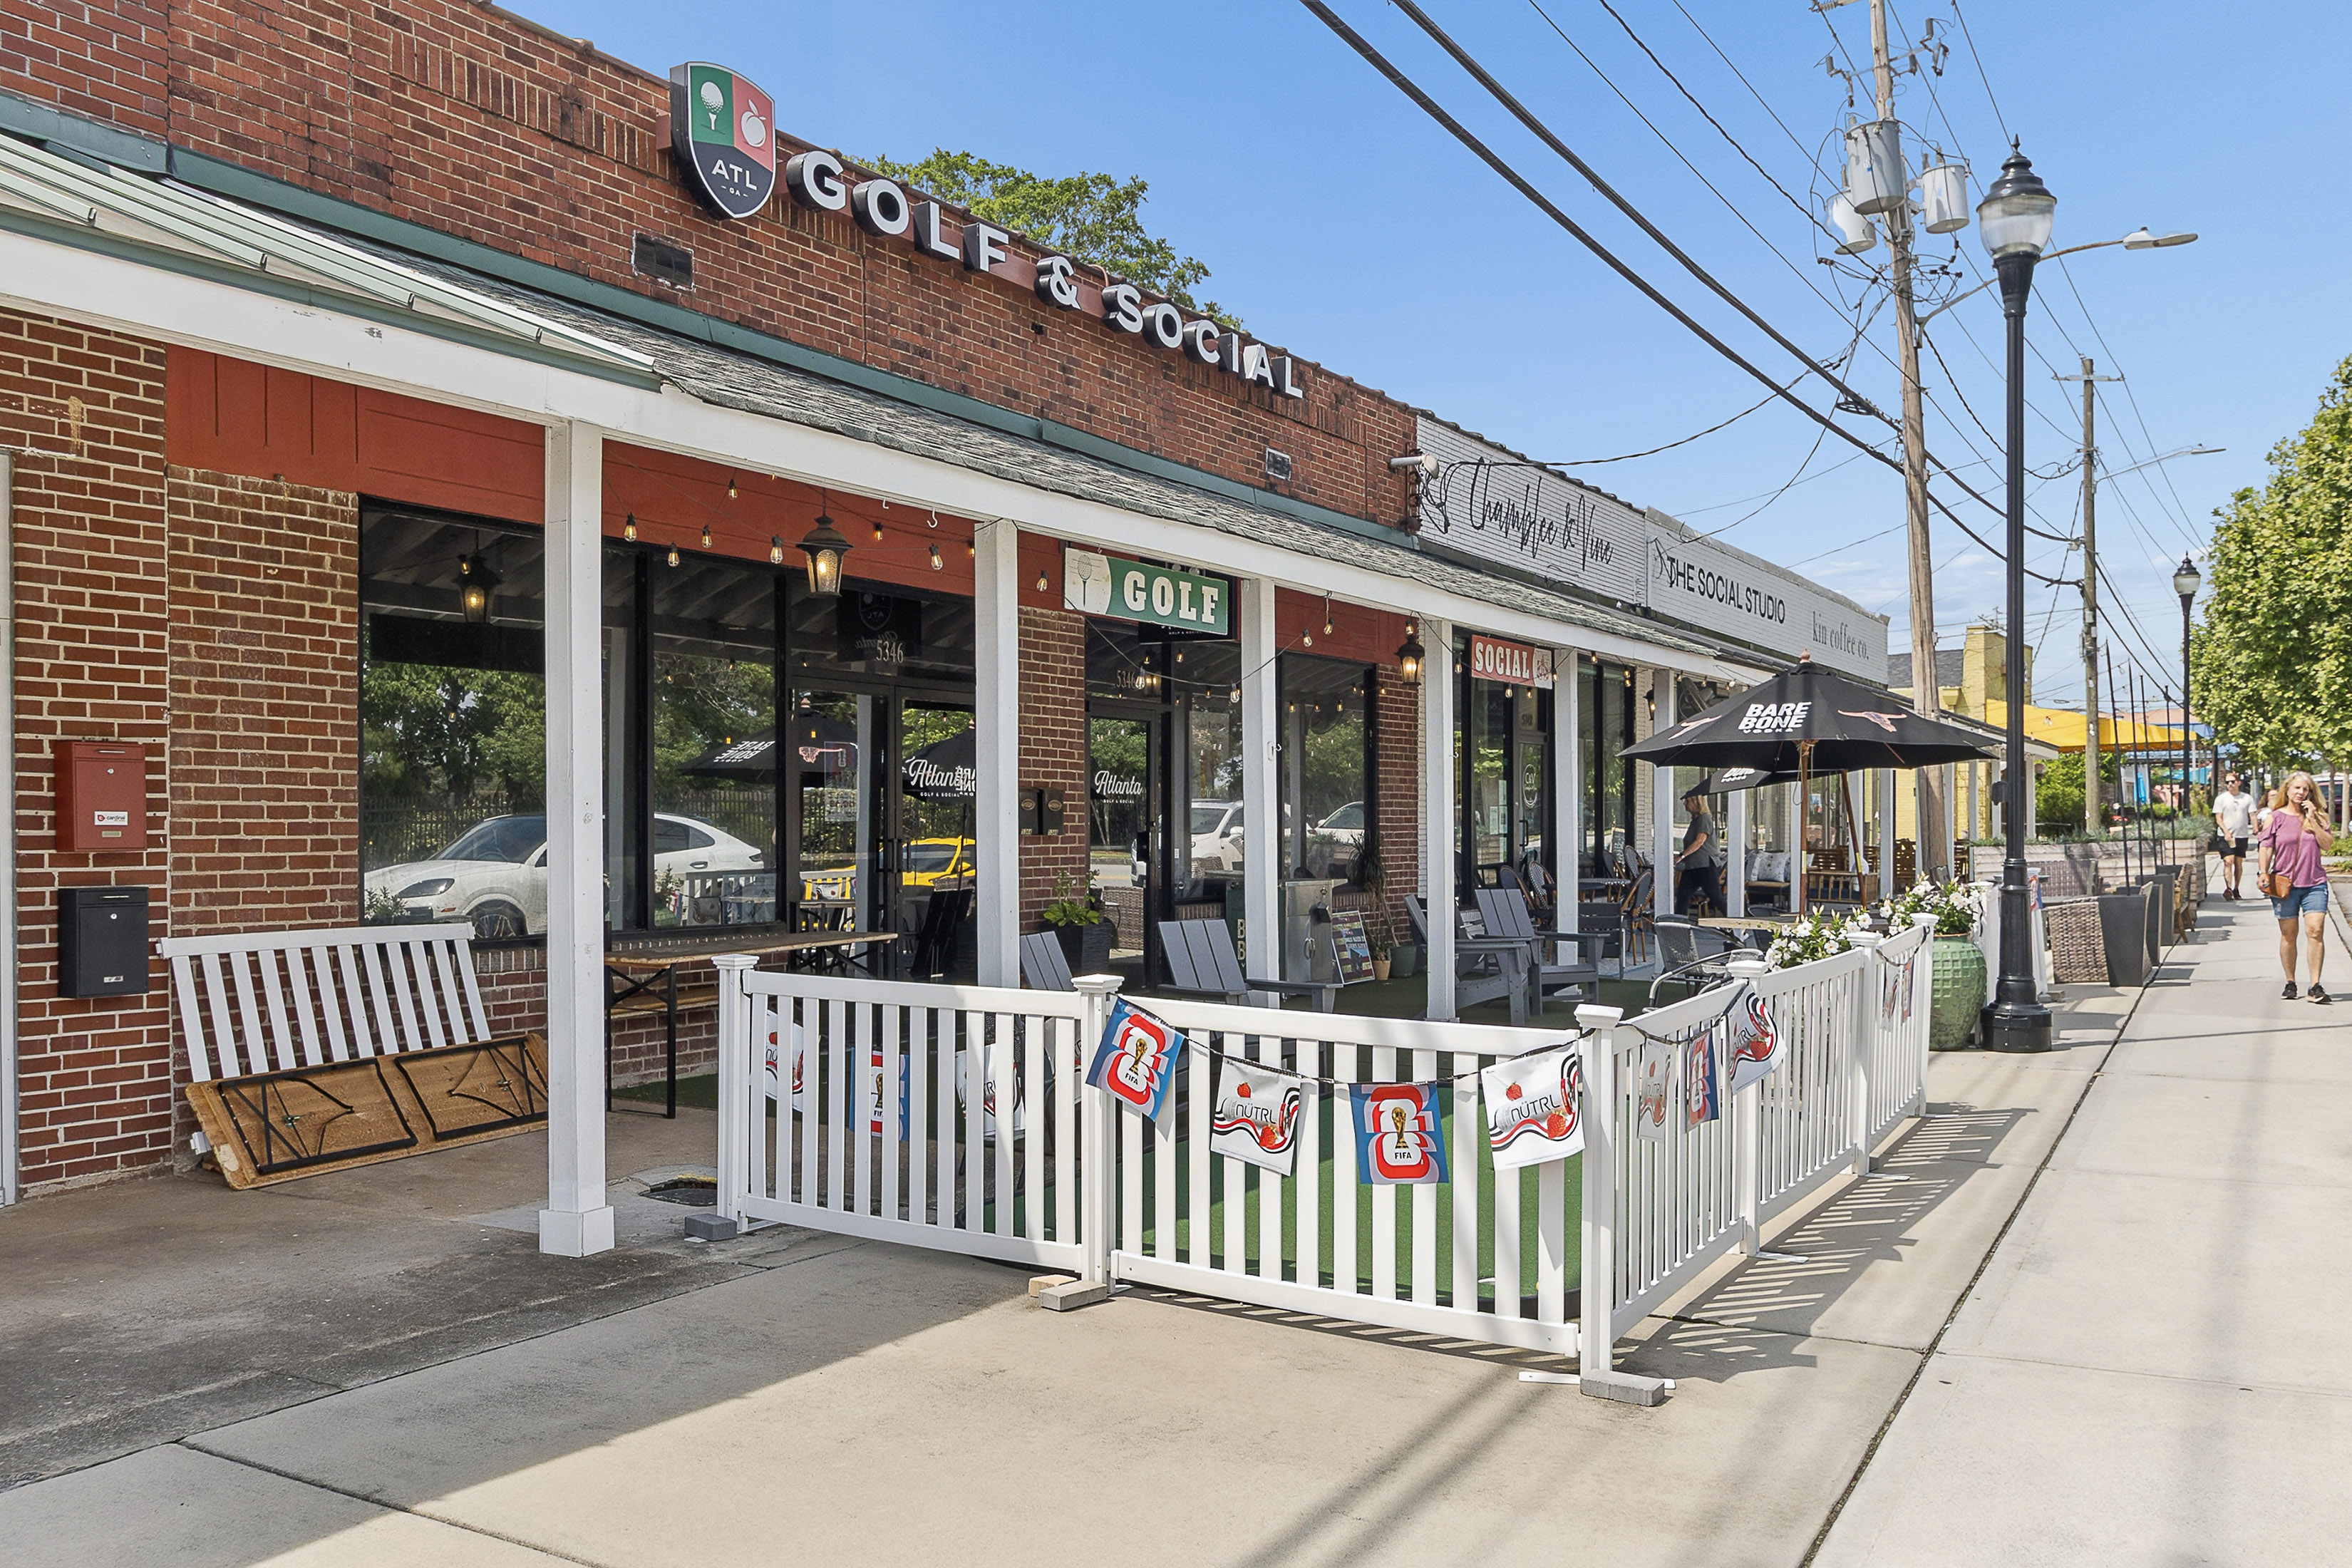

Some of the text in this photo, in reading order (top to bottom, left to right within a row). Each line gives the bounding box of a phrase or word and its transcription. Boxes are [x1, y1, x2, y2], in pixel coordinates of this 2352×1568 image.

[711, 159, 757, 191] ATL
[790, 150, 1304, 400] GOLF & SOCIAL
[1124, 571, 1219, 624] GOLF
[1667, 556, 1786, 624] THE SOCIAL STUDIO
[1812, 611, 1827, 645] kin
[1830, 622, 1856, 655] coffee
[876, 640, 904, 663] 5346
[1475, 642, 1530, 679] SOCIAL
[1738, 715, 1807, 730] BONE
[1745, 701, 1812, 717] BARE
[1095, 770, 1143, 795] Atlanta
[1125, 1073, 1138, 1085] FIFA
